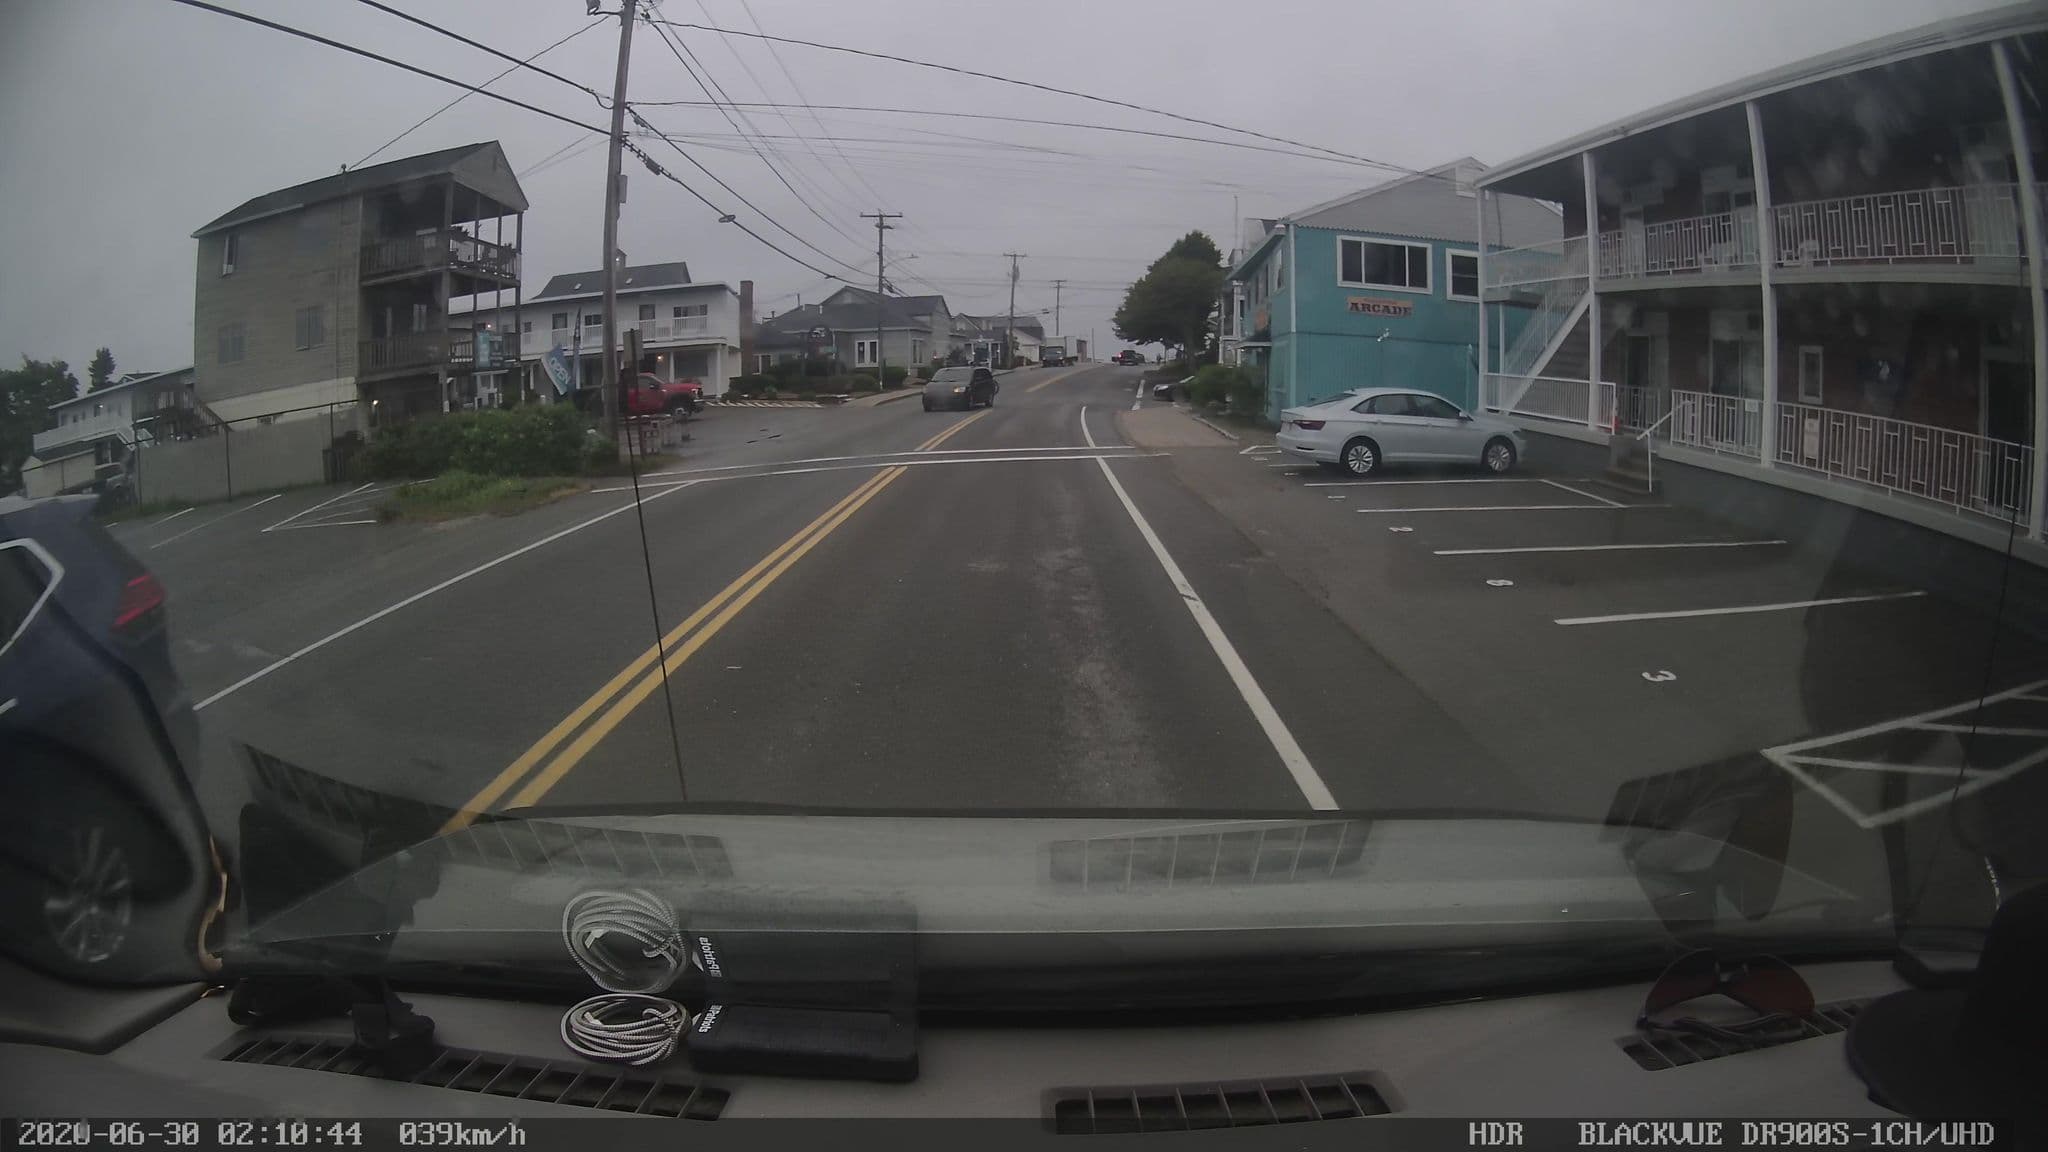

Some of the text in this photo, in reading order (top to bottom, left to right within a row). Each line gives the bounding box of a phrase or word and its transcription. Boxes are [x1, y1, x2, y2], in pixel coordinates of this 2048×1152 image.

[1350, 302, 1413, 315] ARCADE
[548, 356, 571, 385] OPEN
[1642, 670, 1677, 682] 3
[699, 1008, 721, 1033] Patriots
